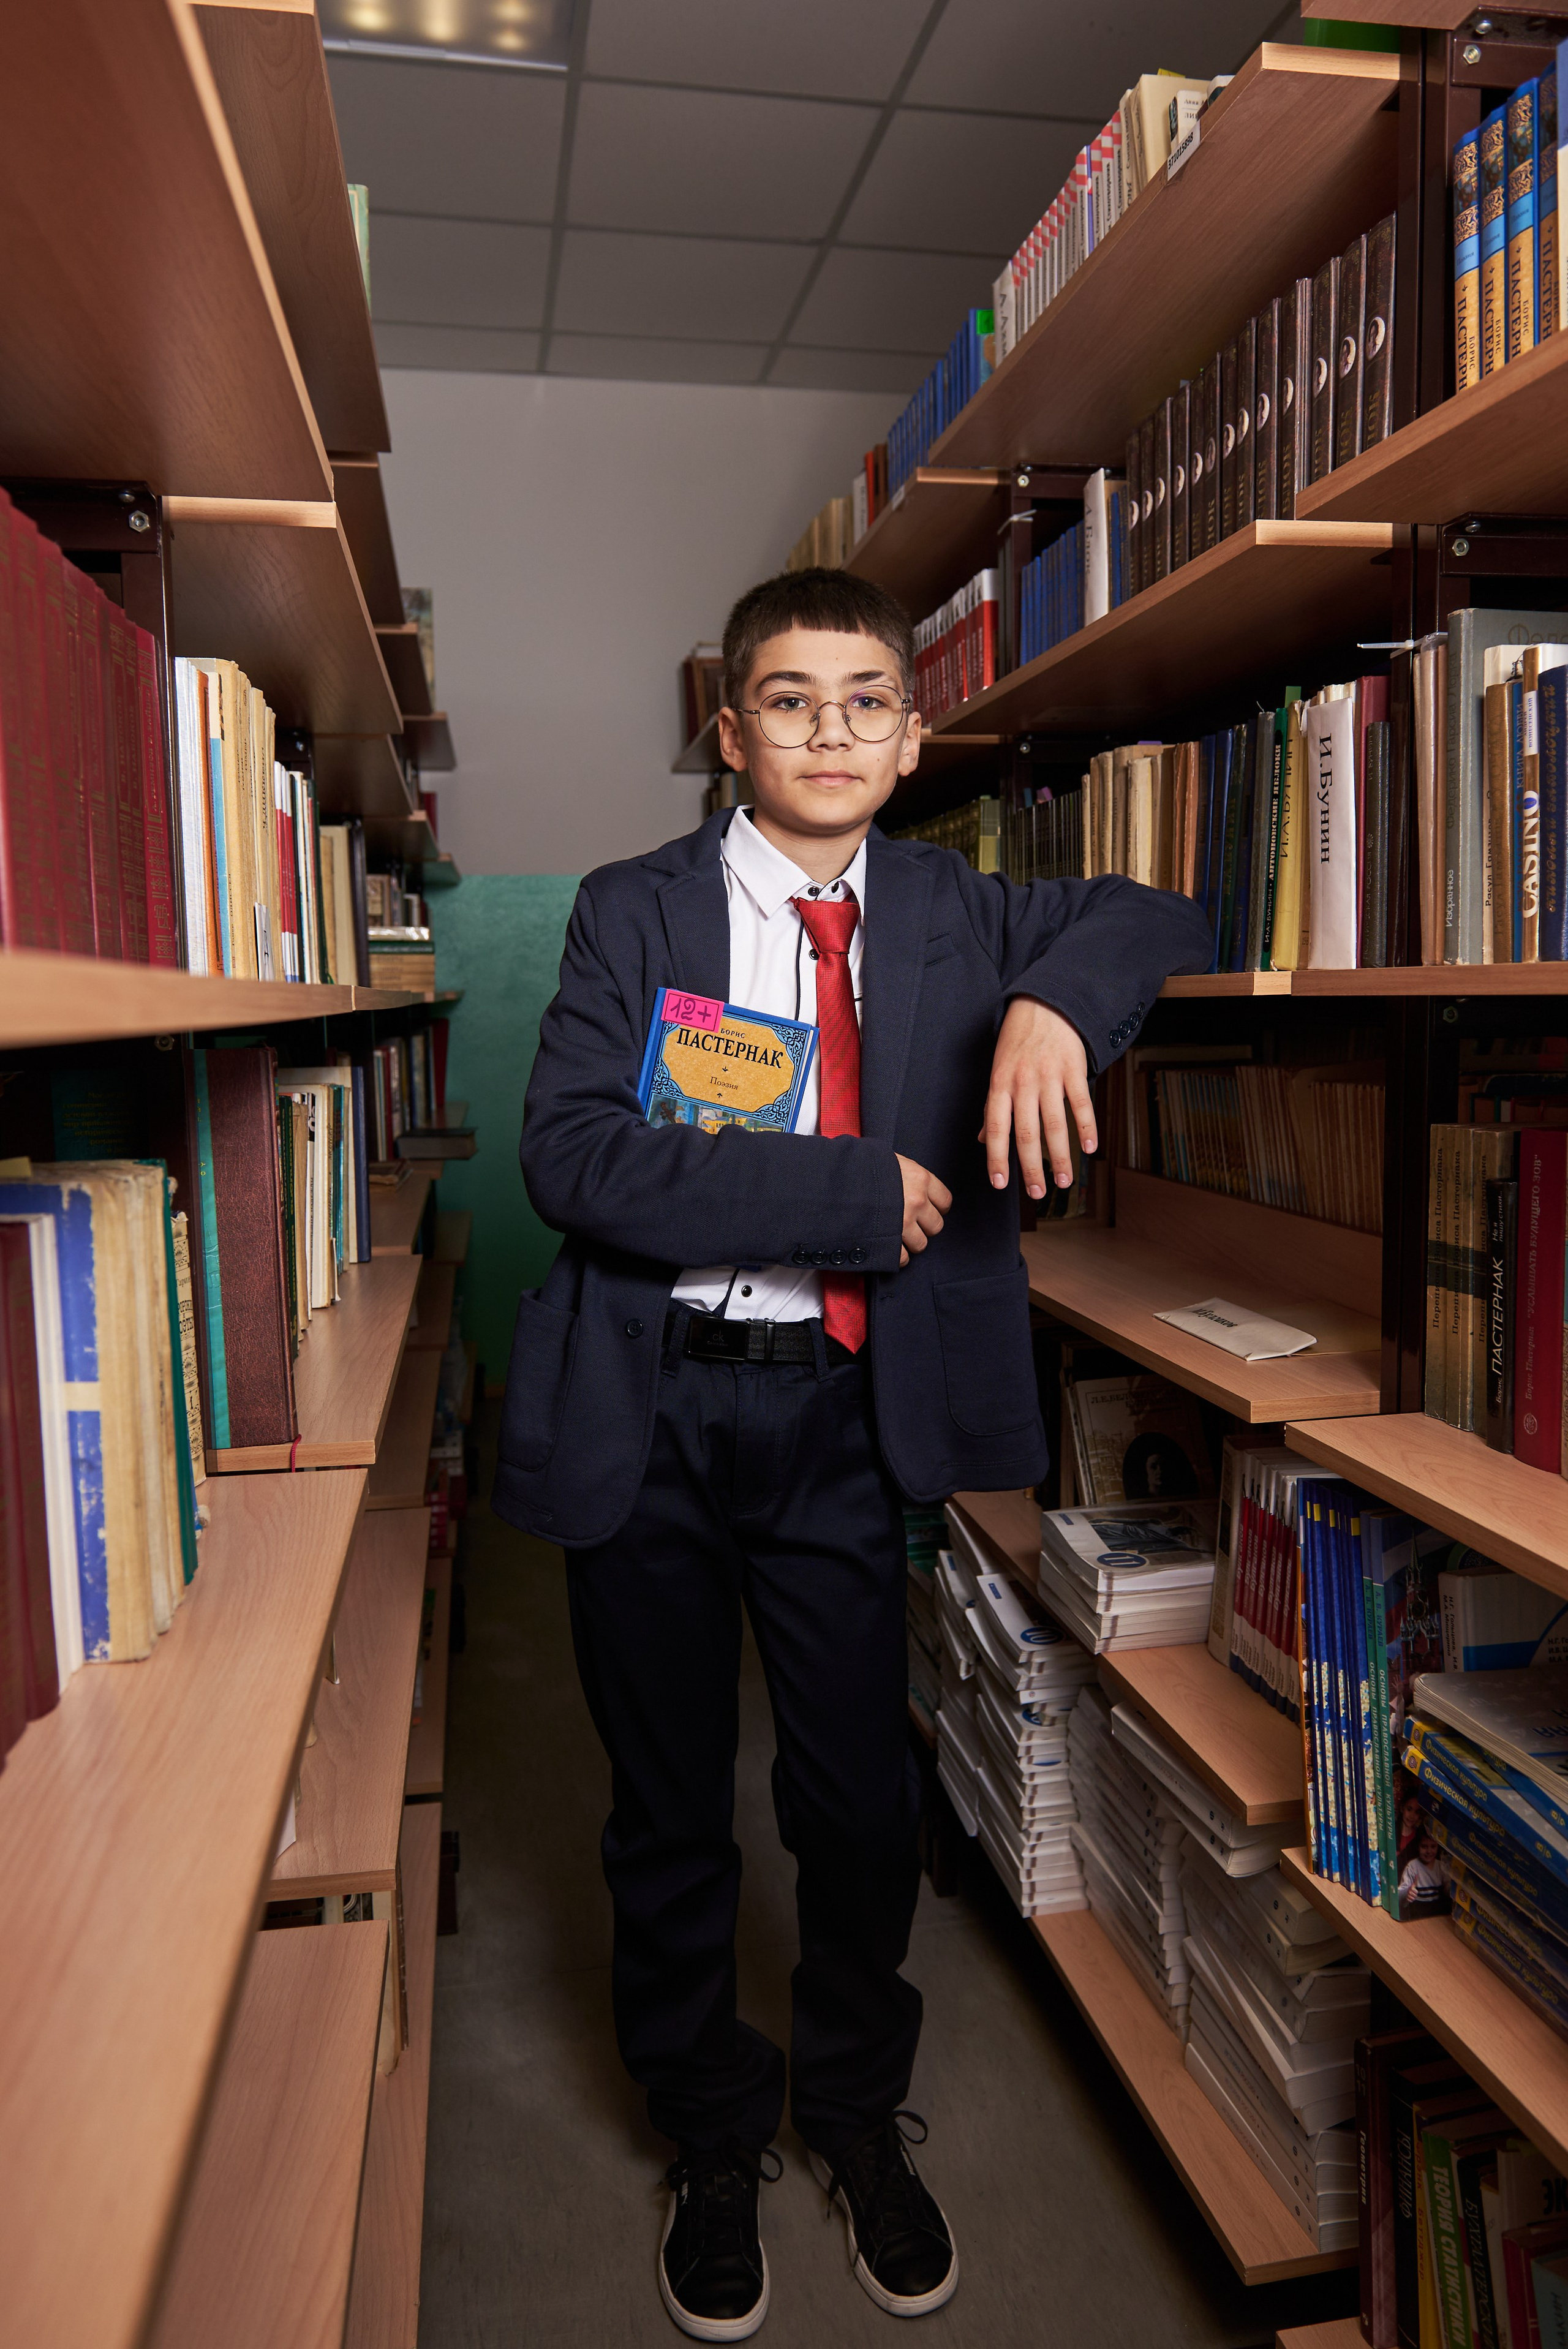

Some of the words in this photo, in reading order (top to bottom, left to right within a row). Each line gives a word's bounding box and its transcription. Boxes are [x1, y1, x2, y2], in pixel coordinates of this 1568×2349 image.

[1168, 132, 1194, 170] 371015898
[1273, 743, 1281, 795] ЯБЛОКИ
[1317, 732, 1333, 864] И.Бунин
[1268, 797, 1279, 881] АНТОНОВСКИЕ
[1522, 790, 1540, 919] CASINO
[1445, 869, 1455, 928] Избранное
[1485, 874, 1493, 907] Расул
[669, 997, 712, 1024] 12+
[720, 1028, 746, 1039] БОРИС
[676, 1027, 784, 1069] ПАСТЕРНАК
[709, 1076, 739, 1091] Поэзия
[1434, 1147, 1444, 1217] Пастернака
[1453, 1150, 1461, 1221] Пастернака
[1434, 1220, 1443, 1262] Бориса
[1452, 1224, 1461, 1267] Бориса
[1491, 1228, 1499, 1242] Не
[1528, 1185, 1540, 1247] БУДУЩЕГО
[1432, 1265, 1442, 1329] Переписка
[1452, 1270, 1461, 1336] Переписка
[1491, 1256, 1504, 1376] ПАСТЕРНАК
[1525, 1325, 1536, 1372] Пастернак
[1495, 1377, 1504, 1404] Борис
[1525, 1374, 1534, 1401] Борис
[1257, 1539, 1267, 1598] Булгаков
[1273, 1552, 1283, 1612] Булгаков
[1375, 1591, 1381, 1601] А.
[1379, 1669, 1388, 1708] ОСНОВЫ
[1381, 1713, 1392, 1787] ПРАВОСЛАВНОЙ
[1425, 1738, 1460, 1776] Физическая
[1461, 1770, 1488, 1802] культура
[1371, 1706, 1382, 1780] ПРАВОСЛАВНОЙ
[1380, 1850, 1386, 1861] 4
[1423, 1766, 1469, 1810] Физическая
[1469, 1801, 1507, 1838] культура
[1385, 1793, 1394, 1841] КУЛЬТУРЫ
[1389, 1860, 1395, 1870] 4
[1468, 1831, 1507, 1871] Физическая
[1507, 1863, 1539, 1897] культура
[1359, 2129, 1369, 2206] Геометрия
[1396, 2128, 1412, 2219] ФИНАНСЫ
[1431, 2164, 1454, 2230] ТЕОРИЯ
[1441, 2236, 1468, 2349] СТАТИСТИКИ
